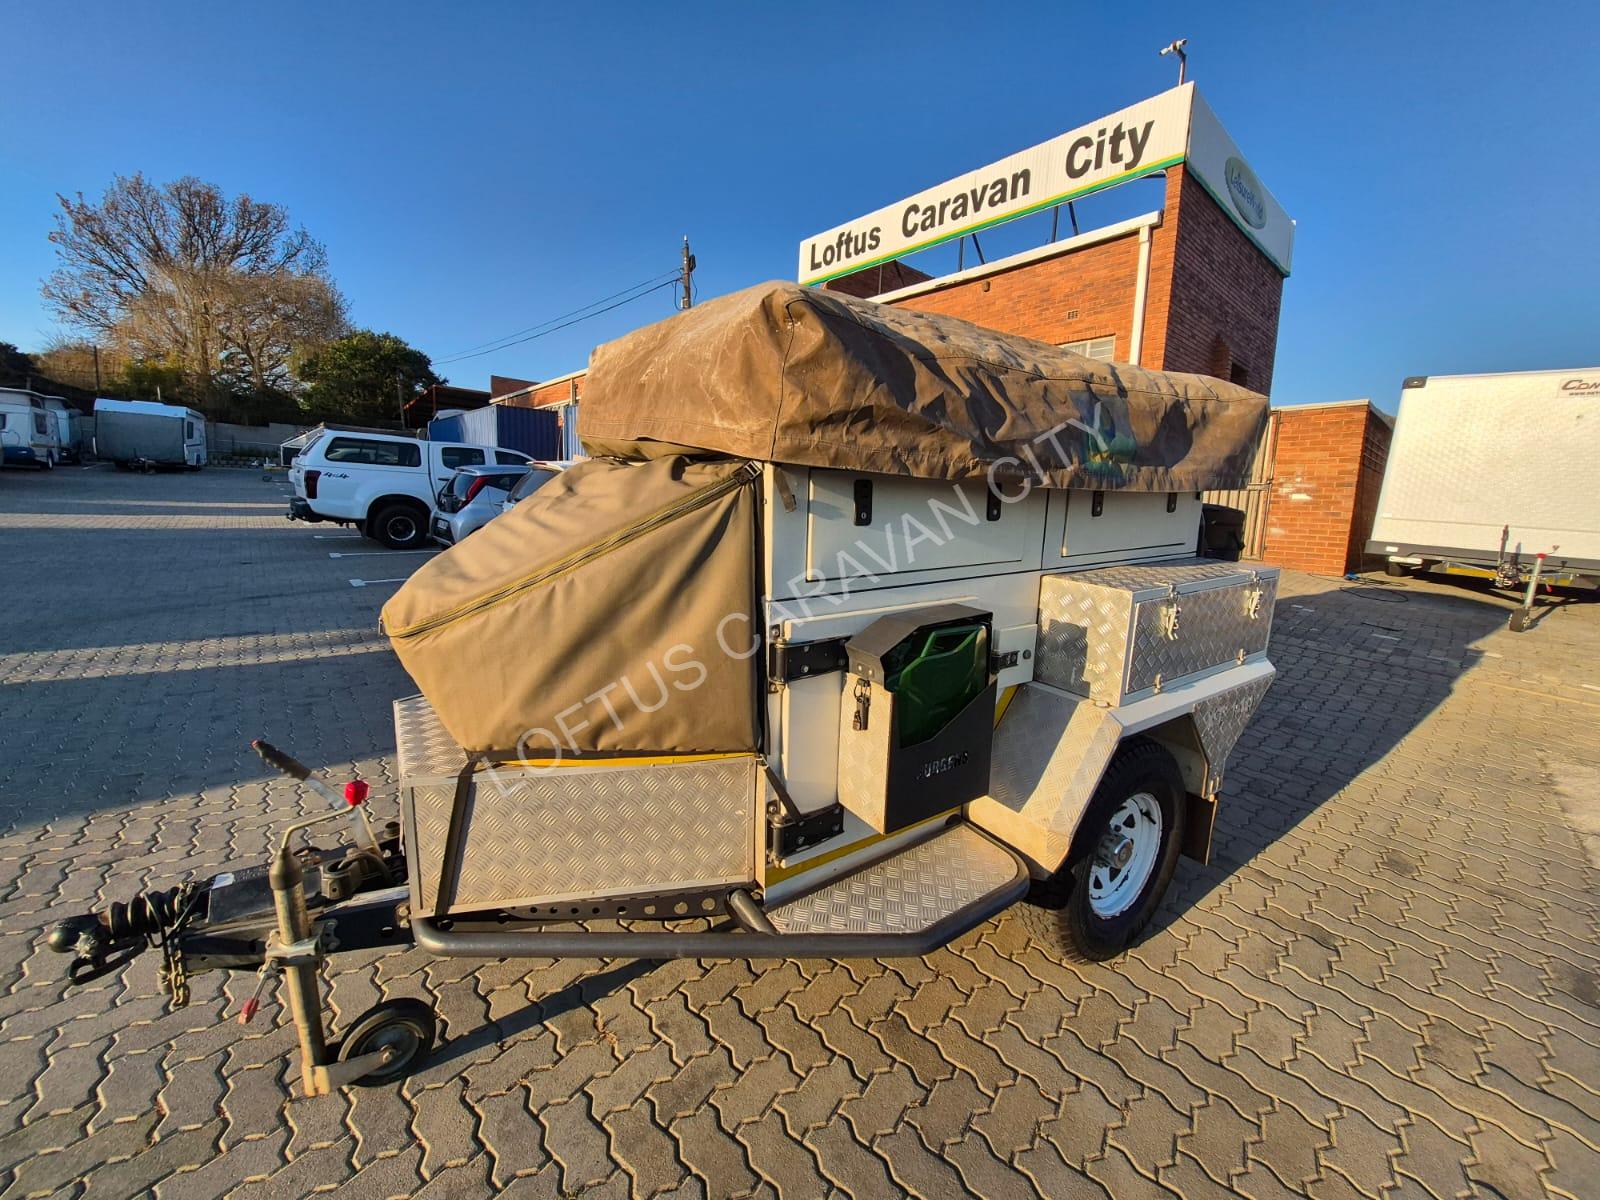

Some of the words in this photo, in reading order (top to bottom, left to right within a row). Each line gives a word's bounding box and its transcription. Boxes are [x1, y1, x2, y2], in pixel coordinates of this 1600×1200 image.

[810, 226, 881, 272] Loftus
[902, 168, 1031, 238] Caravan
[1065, 119, 1155, 180] City
